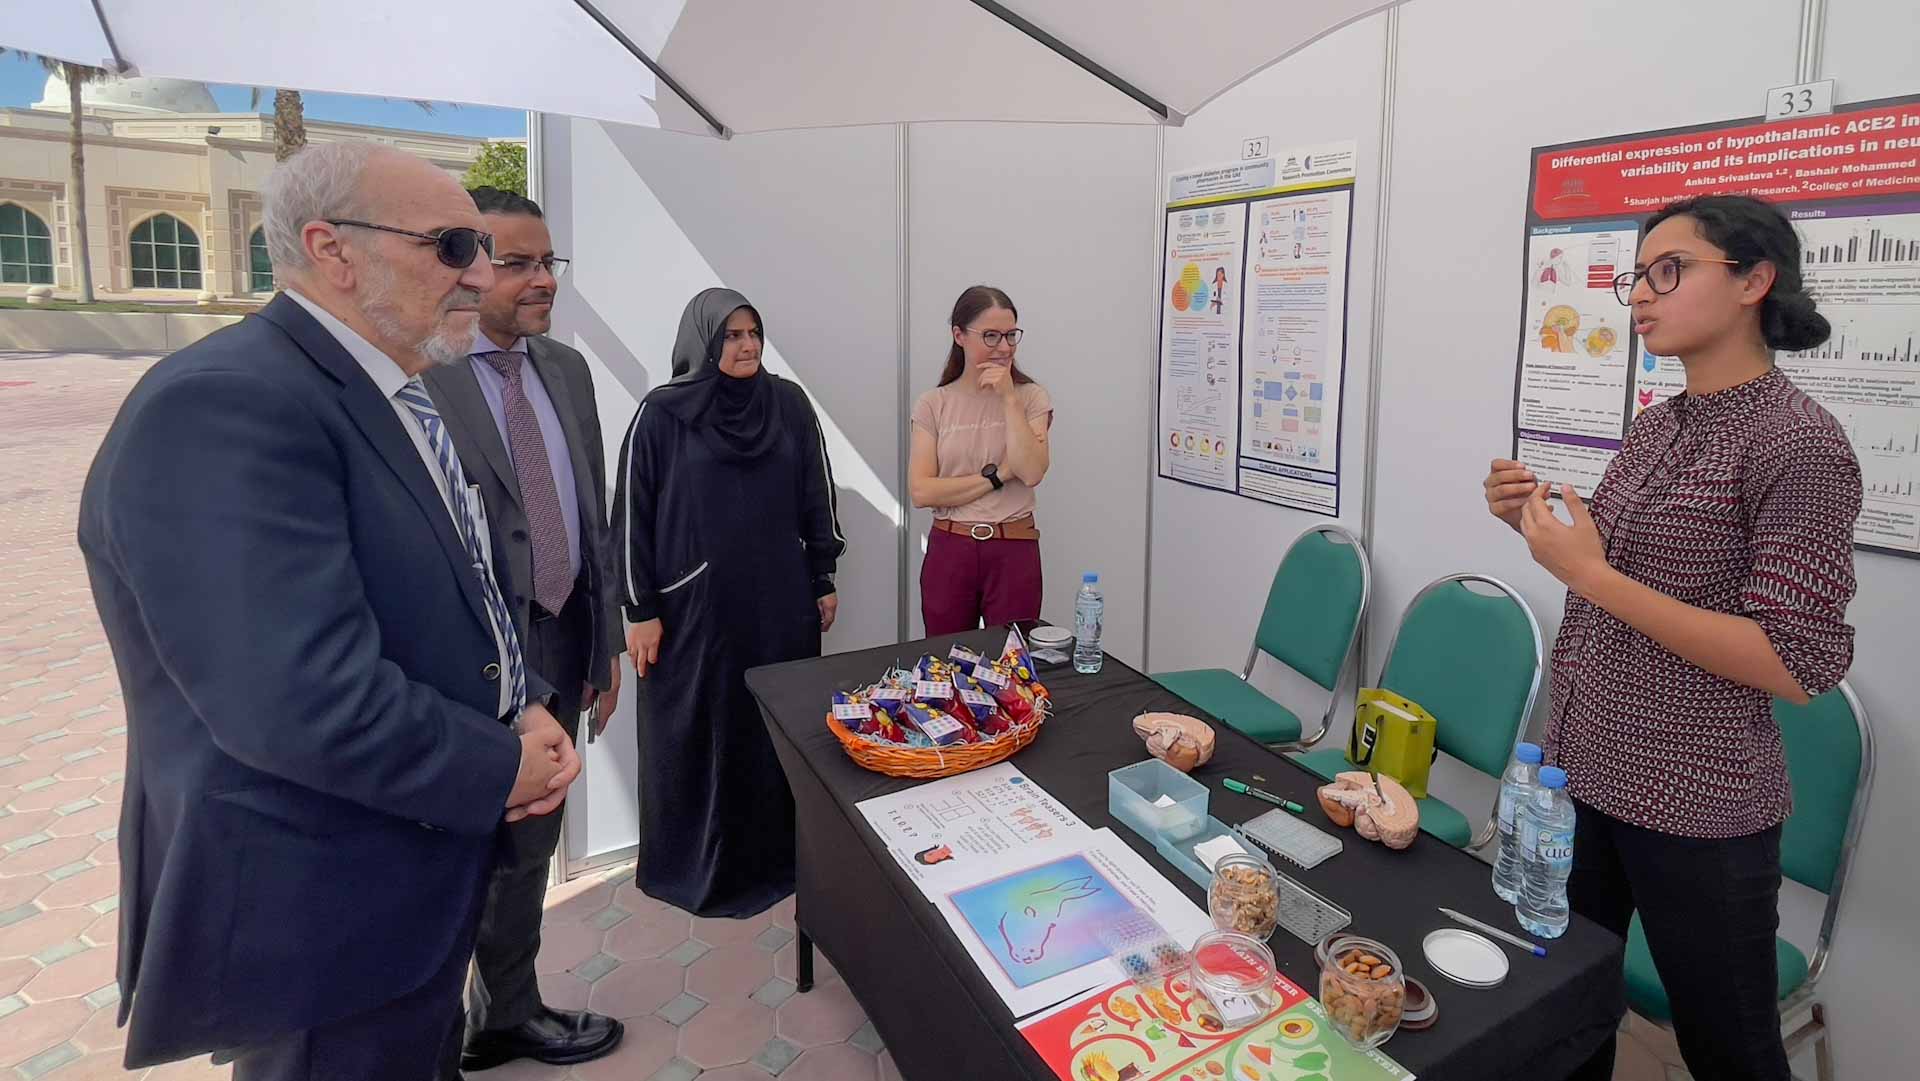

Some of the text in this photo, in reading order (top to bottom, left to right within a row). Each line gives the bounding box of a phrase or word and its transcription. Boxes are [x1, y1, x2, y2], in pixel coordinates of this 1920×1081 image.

[1779, 89, 1813, 116] 33
[1248, 142, 1262, 157] 32
[1552, 114, 1920, 169] Differential expression of hypothalamic ACE2 in
[1621, 161, 1689, 178] variability
[1693, 157, 1720, 170] and
[1724, 153, 1744, 167] its
[1747, 143, 1855, 163] implications
[1860, 140, 1878, 153] in
[1685, 175, 1716, 187] Ankita
[1718, 171, 1773, 184] Srivastava
[1795, 166, 1839, 178] Bashair
[1842, 159, 1916, 173] Mohammed
[1852, 179, 1863, 188] of
[1791, 210, 1827, 219] Results
[1533, 226, 1572, 235] Background
[1520, 431, 1550, 441] Objectives
[1259, 463, 1313, 479] CLINICAL APPLICATIONS
[1020, 783, 1040, 799] Brain
[1040, 798, 1068, 822] Teasers
